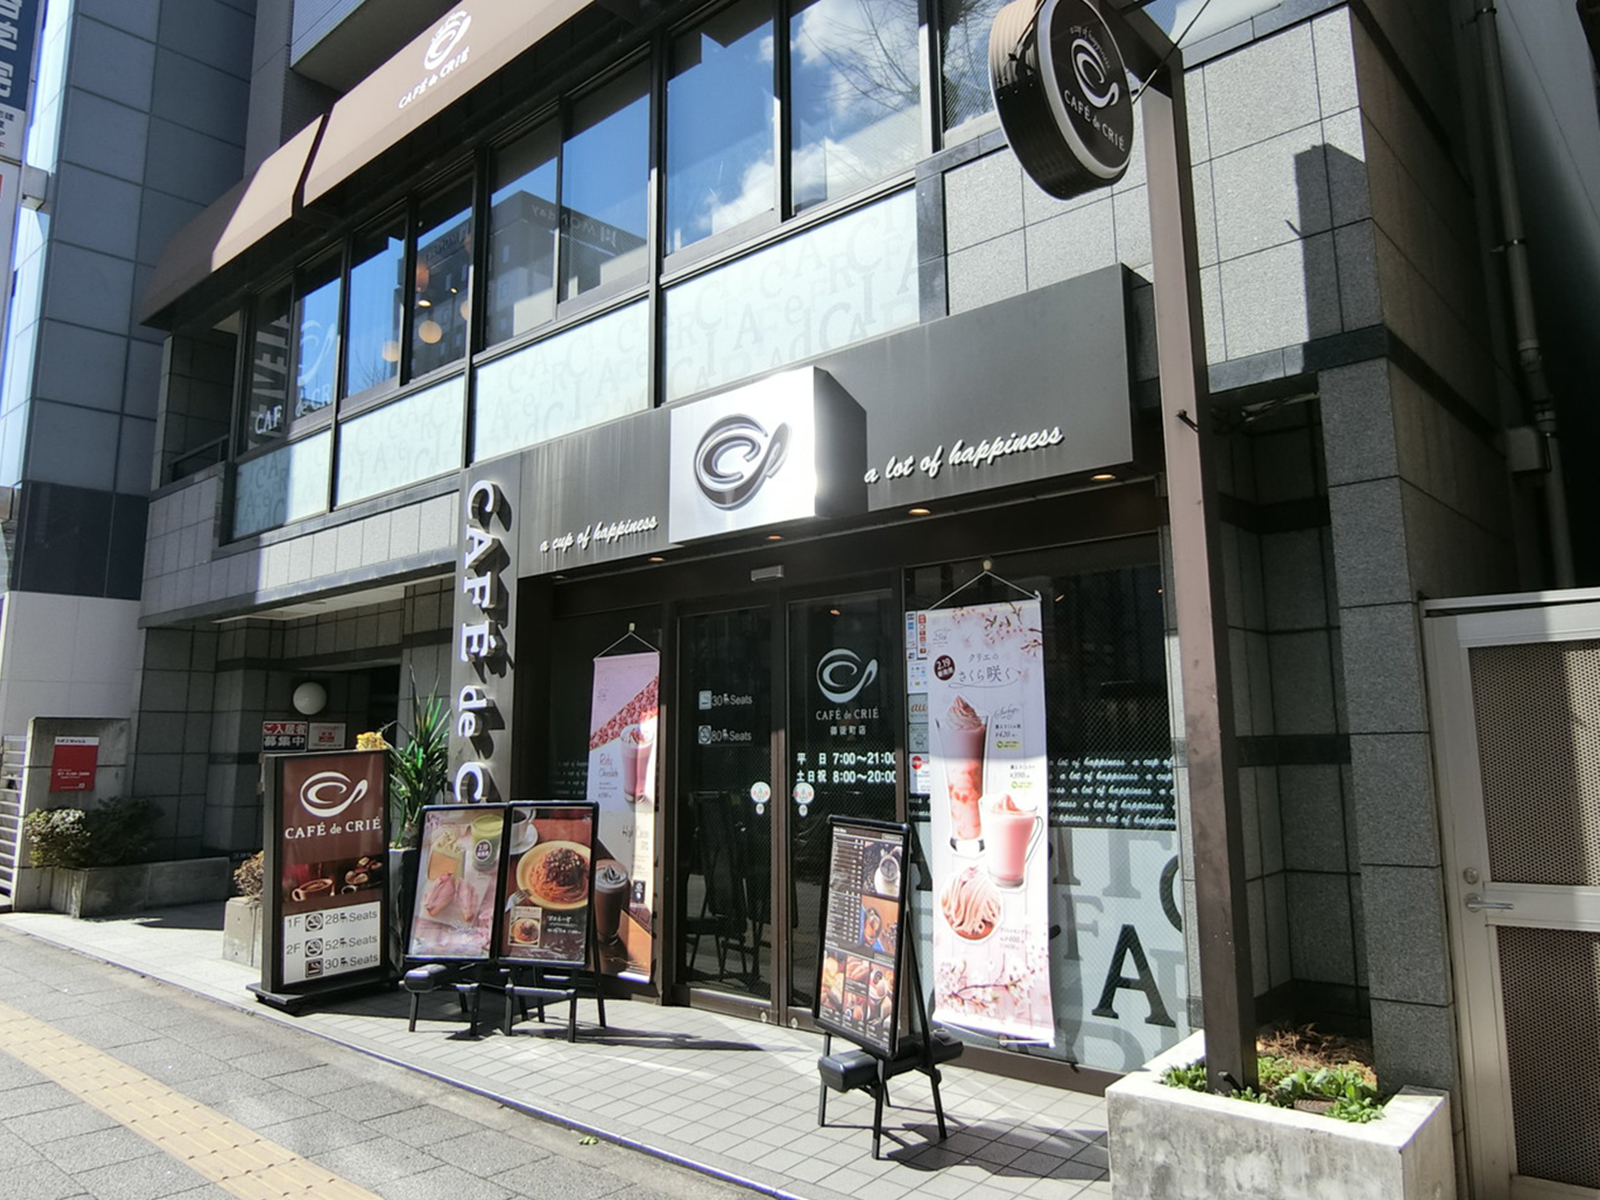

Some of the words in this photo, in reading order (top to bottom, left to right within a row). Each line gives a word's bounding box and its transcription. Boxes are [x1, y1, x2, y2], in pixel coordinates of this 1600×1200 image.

[399, 77, 428, 109] CAFÉ
[440, 46, 470, 78] CRIÉ
[1064, 89, 1091, 122] CAFÉ
[1102, 123, 1125, 152] CRIÉ
[864, 468, 879, 484] a
[885, 456, 915, 479] lot
[920, 445, 945, 478] of
[949, 426, 1063, 468] happiness
[540, 541, 549, 552] a
[552, 532, 574, 552] cup
[576, 525, 591, 549] of
[593, 515, 658, 544] happiness
[461, 480, 501, 662] CAFÉ
[936, 658, 951, 669] 2.19
[968, 652, 999, 663] クリエの
[959, 665, 1011, 683] さくら咲く
[711, 695, 723, 706] 30
[729, 694, 753, 706] Seats
[458, 685, 488, 738] de
[816, 709, 842, 720] CAFÉ
[853, 706, 879, 719] CRIÉ
[910, 704, 928, 713] au
[264, 735, 305, 747] 募集中
[711, 730, 723, 742] 80
[729, 730, 752, 742] Seats
[1083, 757, 1125, 768] happiness
[1143, 758, 1160, 768] cup
[796, 769, 827, 783] 土日祝
[1069, 771, 1081, 780] lot
[1083, 771, 1093, 783] of
[1096, 771, 1139, 782] happiness
[1081, 785, 1093, 794] lot
[1096, 785, 1106, 797] of
[1108, 785, 1152, 796] happiness
[1093, 799, 1105, 809] lot
[1108, 800, 1118, 812] of
[1120, 800, 1164, 811] happiness
[1105, 814, 1118, 823] lot
[1121, 815, 1131, 827] of
[284, 821, 326, 840] CAFÉ
[329, 823, 342, 835] de
[345, 818, 381, 833] CRIÉ
[287, 916, 301, 929] 1F
[325, 912, 339, 926] 28
[348, 909, 378, 923] Seats
[286, 943, 301, 956] 2F
[324, 939, 339, 951] 52
[348, 934, 378, 948] Seats
[324, 957, 339, 970] 30
[350, 953, 378, 967] Seats
